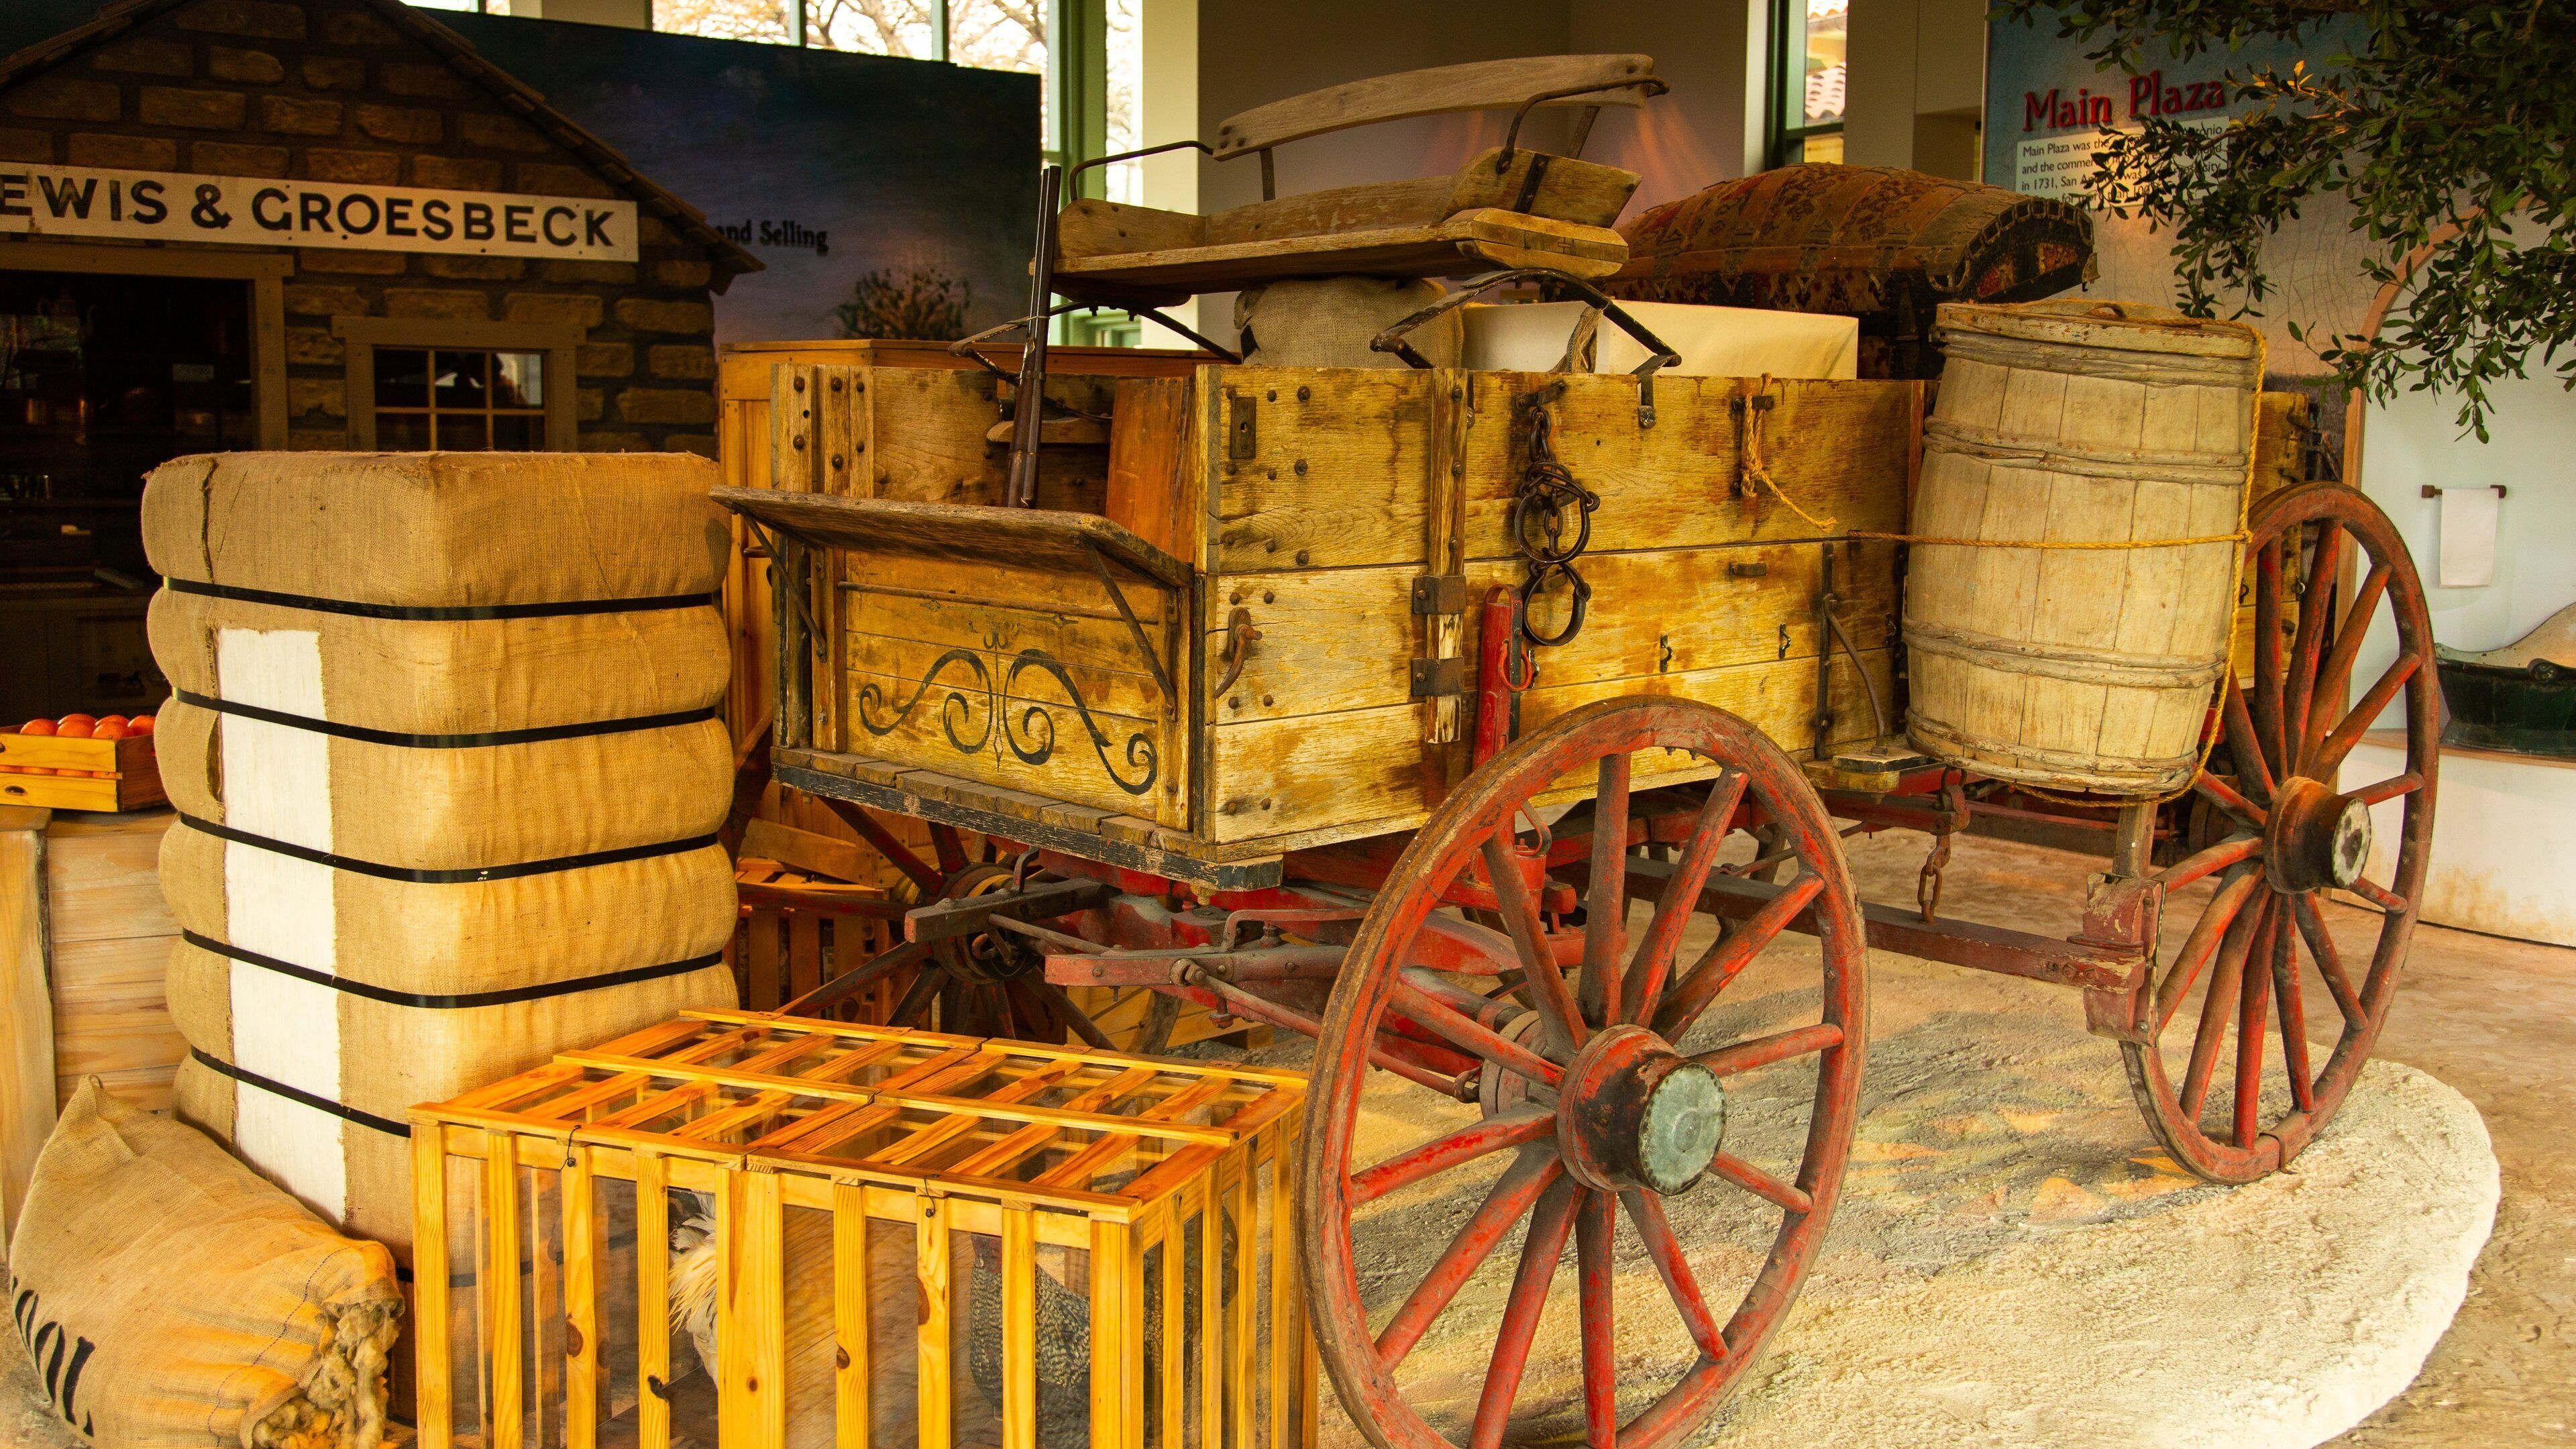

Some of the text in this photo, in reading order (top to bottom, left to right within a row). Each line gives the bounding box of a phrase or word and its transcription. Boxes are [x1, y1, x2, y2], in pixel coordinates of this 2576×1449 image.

[2022, 70, 2226, 132] Main Plaza
[2023, 146, 2045, 157] Main
[2047, 143, 2070, 154] Plaza
[2073, 142, 2091, 151] was
[2094, 138, 2109, 149] the
[2021, 180, 2030, 191] in
[2034, 177, 2058, 190] 1731,
[2061, 176, 2077, 188] San
[2123, 170, 2142, 180] was
[2022, 162, 2038, 174] and
[2040, 161, 2055, 173] the
[191, 183, 233, 229] &
[252, 186, 615, 247] GROESBECK
[759, 219, 829, 255] Selling
